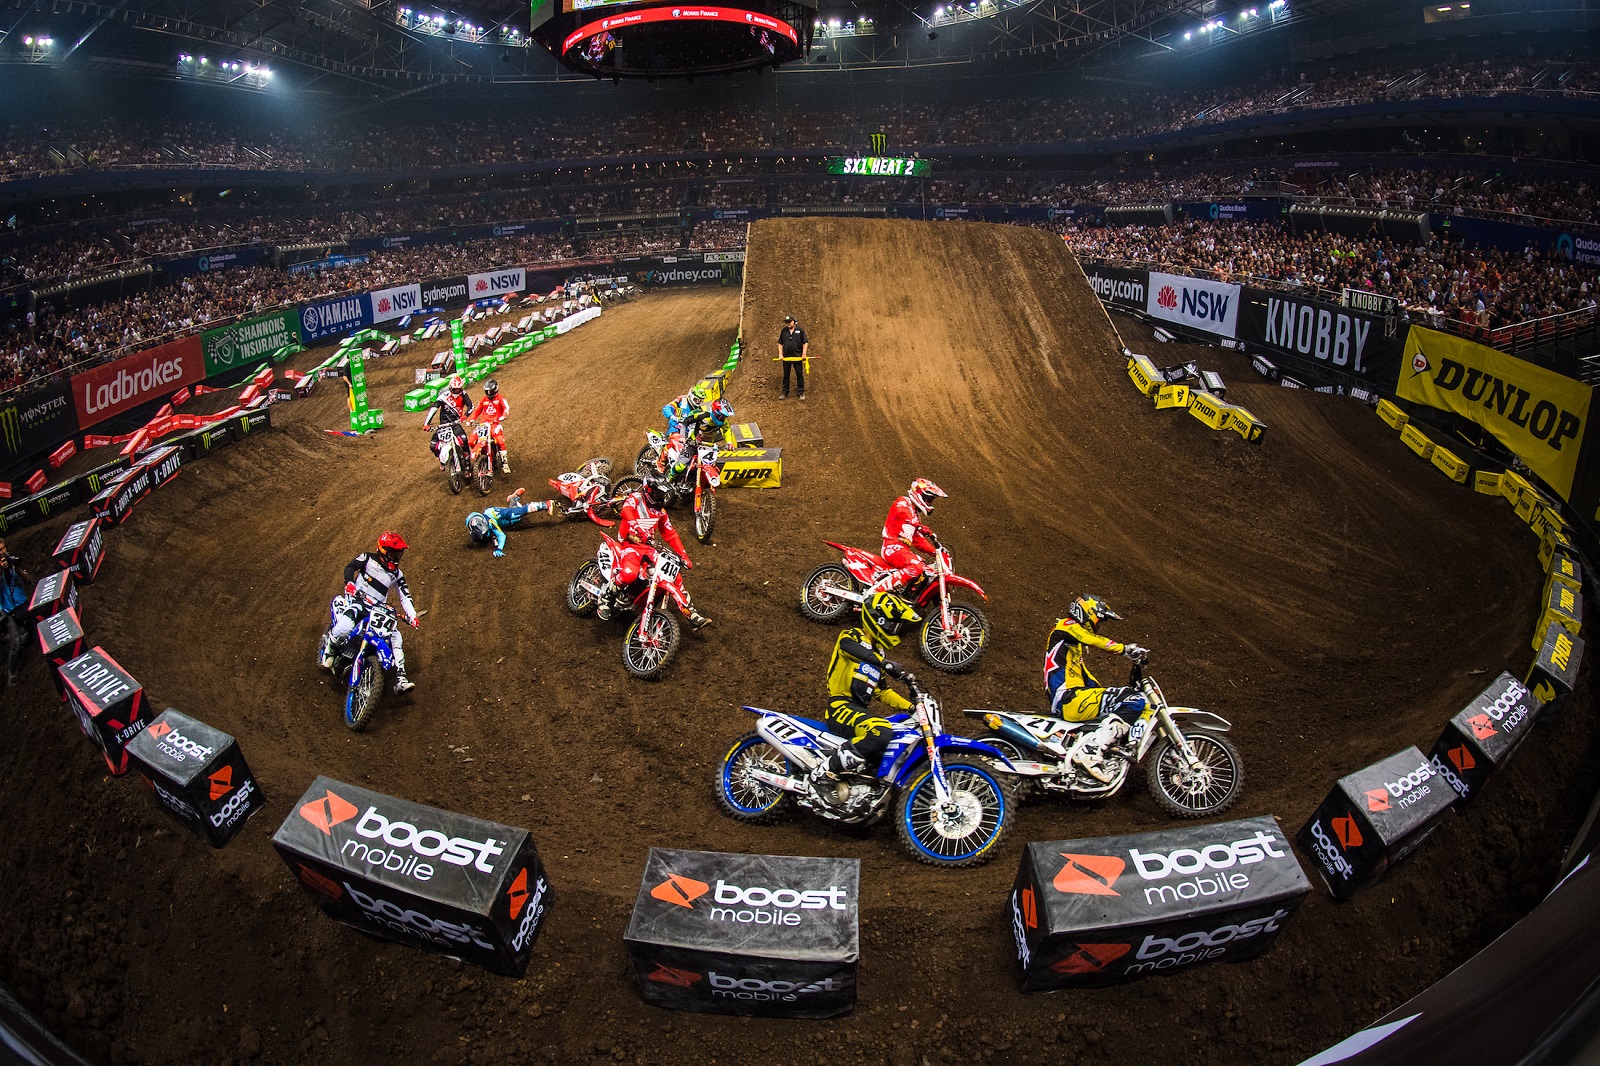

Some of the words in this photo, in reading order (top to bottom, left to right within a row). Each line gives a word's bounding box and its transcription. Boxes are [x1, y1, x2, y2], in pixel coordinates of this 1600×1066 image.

[843, 158, 867, 173] SX1
[871, 158, 903, 174] HEAT
[905, 160, 914, 175] 2
[1576, 238, 1600, 251] Qudo
[423, 283, 466, 306] sydney.com
[490, 273, 520, 290] NSW
[1088, 272, 1144, 302] dney.com
[318, 298, 362, 327] YAMAHA
[393, 291, 416, 309] NSW
[1181, 288, 1229, 323] NSW
[1352, 292, 1383, 311] KNOBBY
[238, 317, 286, 342] SHANNONS
[311, 320, 361, 338] RACING
[1265, 297, 1370, 372] KNOBBY
[240, 332, 289, 359] INSURANCE
[85, 357, 183, 415] Ladbrokes
[1132, 367, 1148, 388] THOR
[1194, 400, 1216, 419] THOR
[1433, 358, 1580, 451] DUNLOP
[440, 431, 452, 440] 56
[1232, 416, 1248, 433] THOR
[1405, 432, 1424, 449] DUNLOP
[154, 452, 181, 485] X-DRIVE
[702, 452, 714, 461] 4
[1436, 454, 1456, 471] DUNLOP
[127, 473, 149, 499] X-DRIVE
[723, 468, 772, 480] THOR
[660, 561, 678, 580] 414
[48, 613, 72, 645] X-DRIVE
[371, 613, 395, 632] 34
[1551, 633, 1574, 672] THOR
[67, 653, 130, 704] X-DRIVE
[1482, 680, 1527, 721] boost
[768, 719, 798, 739] 111
[832, 705, 866, 727] FOX
[1028, 717, 1056, 732] 21
[1502, 703, 1528, 733] mobile
[115, 719, 146, 744] X-DRIVE
[165, 728, 212, 761] boost
[157, 741, 186, 762] mobile
[1385, 761, 1436, 798] boost
[1431, 754, 1470, 798] boost
[210, 780, 254, 827] boost
[1399, 784, 1431, 810] mobile
[226, 801, 250, 827] mobile
[355, 805, 503, 874] boost
[1310, 819, 1354, 880] boost
[340, 839, 434, 881] mobile
[1129, 831, 1286, 880] boost
[1312, 842, 1335, 876] mobile
[714, 880, 846, 910] boost
[1144, 872, 1250, 905] mobile
[342, 881, 495, 950] boost
[512, 877, 548, 952] boost
[524, 904, 544, 946] mobile
[710, 908, 801, 926] mobile
[1135, 909, 1289, 960] boost
[1123, 947, 1226, 975] mobile
[708, 971, 841, 993] boost
